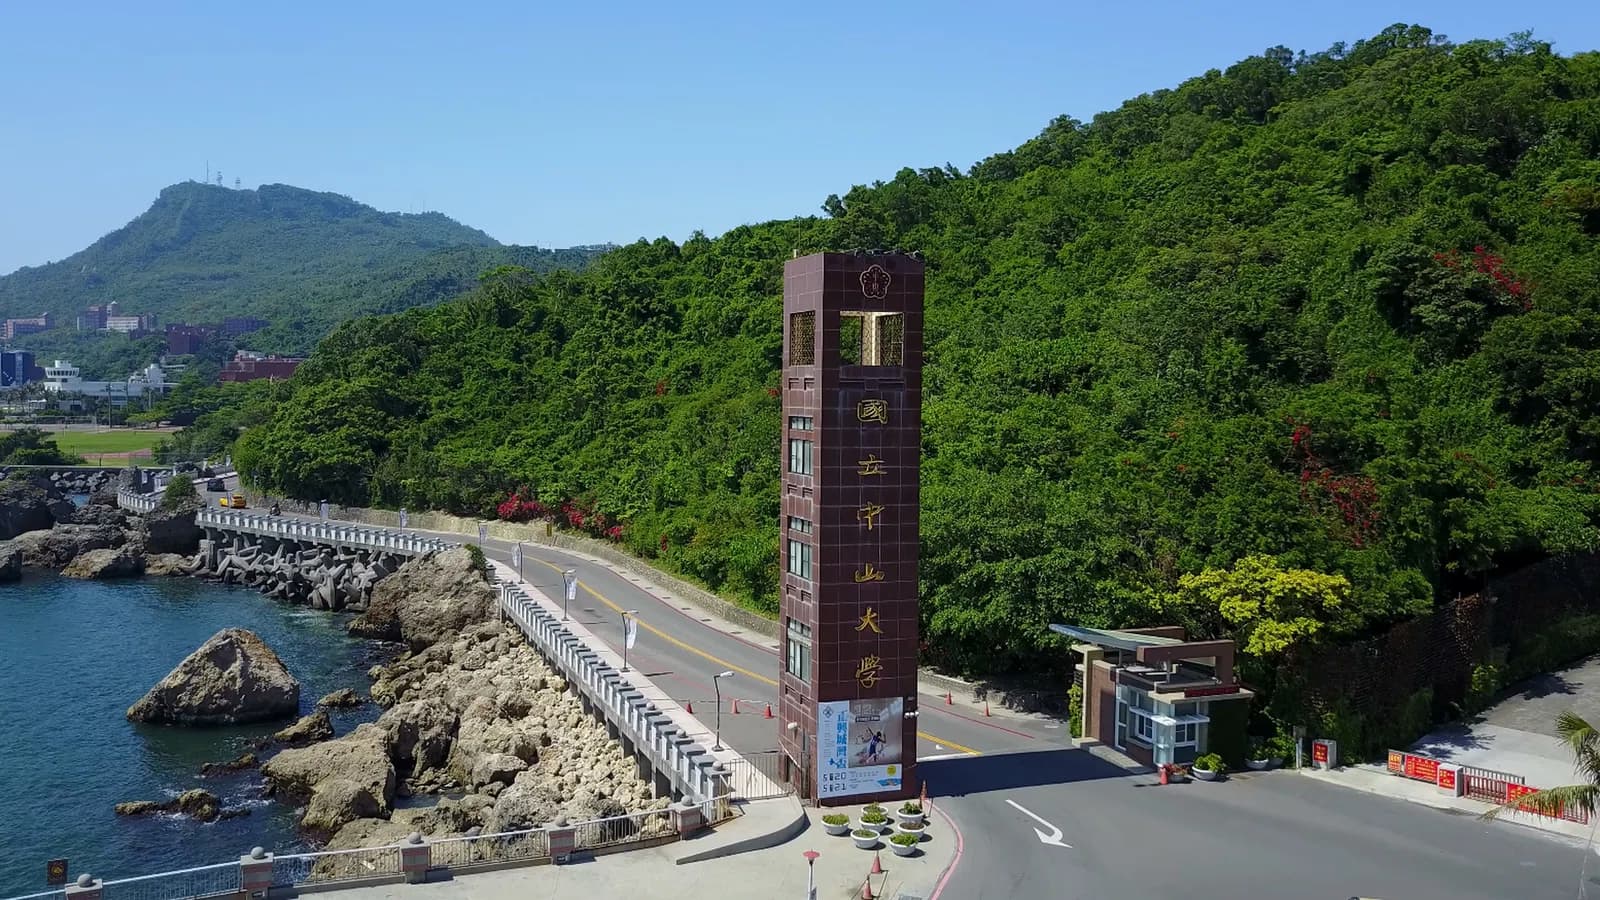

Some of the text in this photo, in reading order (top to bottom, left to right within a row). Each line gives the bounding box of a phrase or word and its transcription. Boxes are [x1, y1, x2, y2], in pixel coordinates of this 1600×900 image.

[855, 400, 888, 688] 國立中山大學
